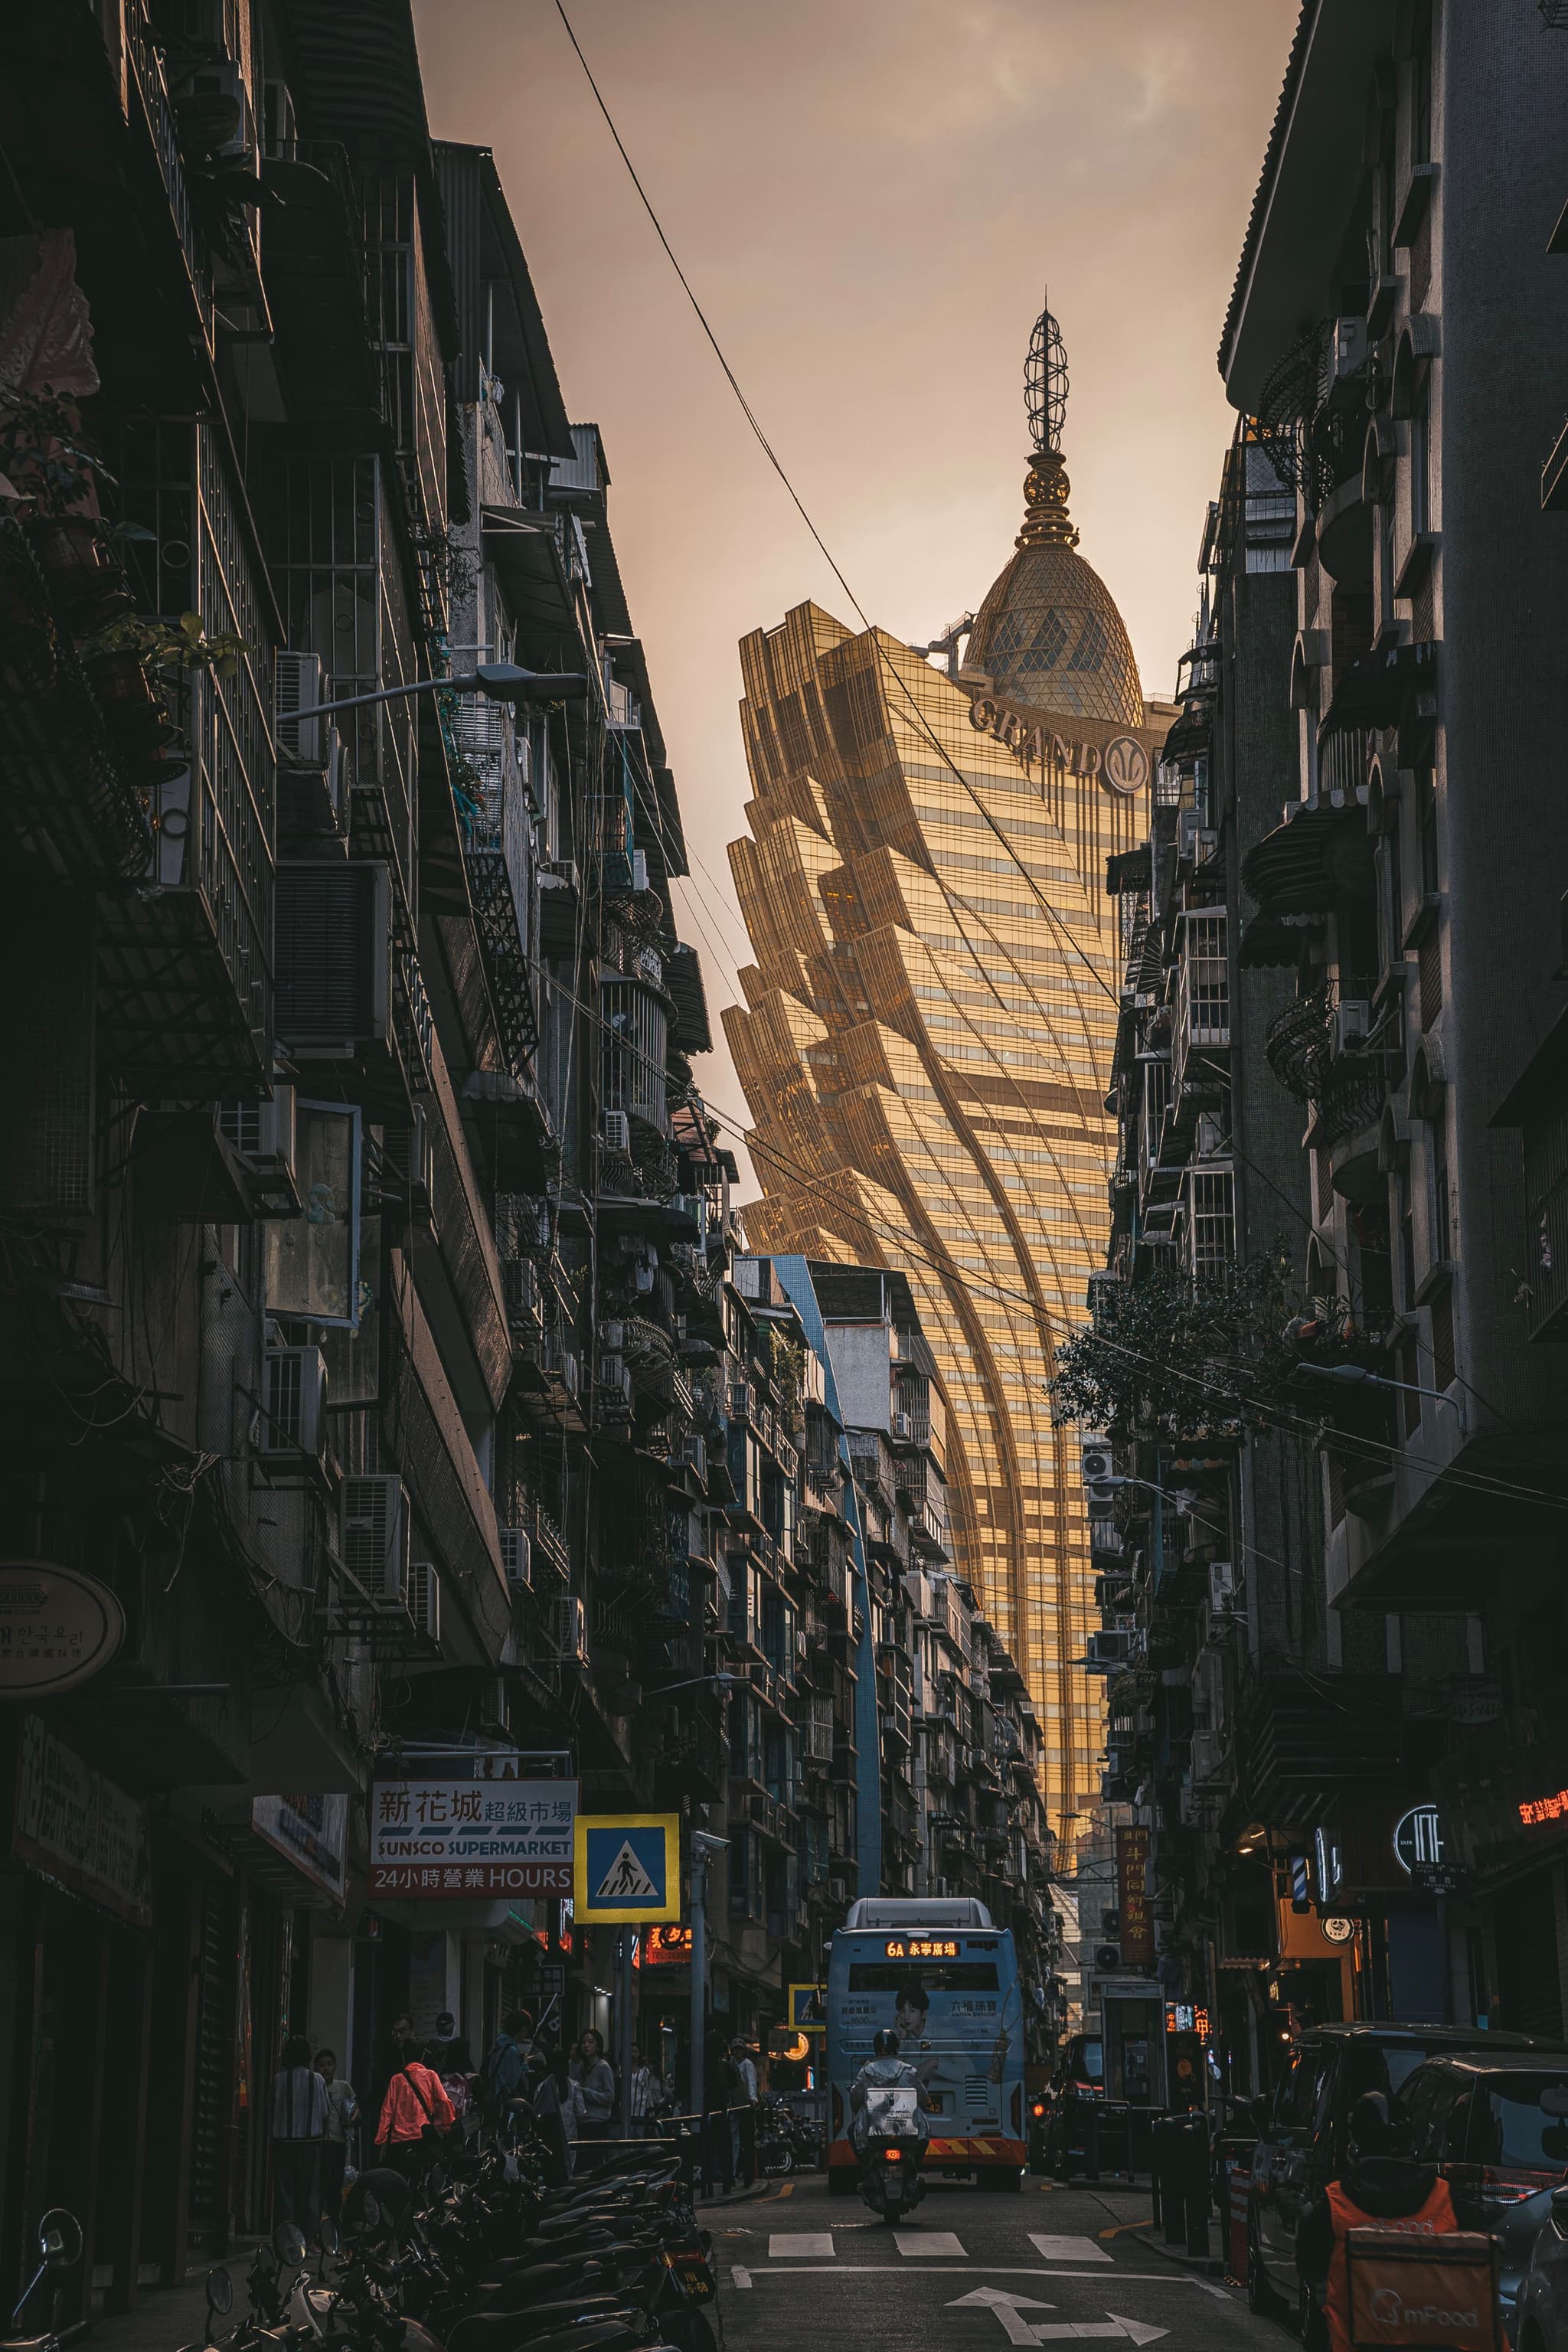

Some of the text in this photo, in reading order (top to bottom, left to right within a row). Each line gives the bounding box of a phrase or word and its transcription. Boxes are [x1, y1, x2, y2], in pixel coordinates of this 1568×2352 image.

[969, 699, 1102, 774] GRAND
[18, 1625, 83, 1645] 한국요리
[378, 1790, 571, 1824] 新花城 超級市場
[378, 1841, 570, 1857] SUNSCO SUPERMARKET
[374, 1868, 570, 1889] 24小時營業 HOURS
[887, 1942, 956, 1957] 6A 永寧廣場
[1403, 2306, 1478, 2328] mFood
